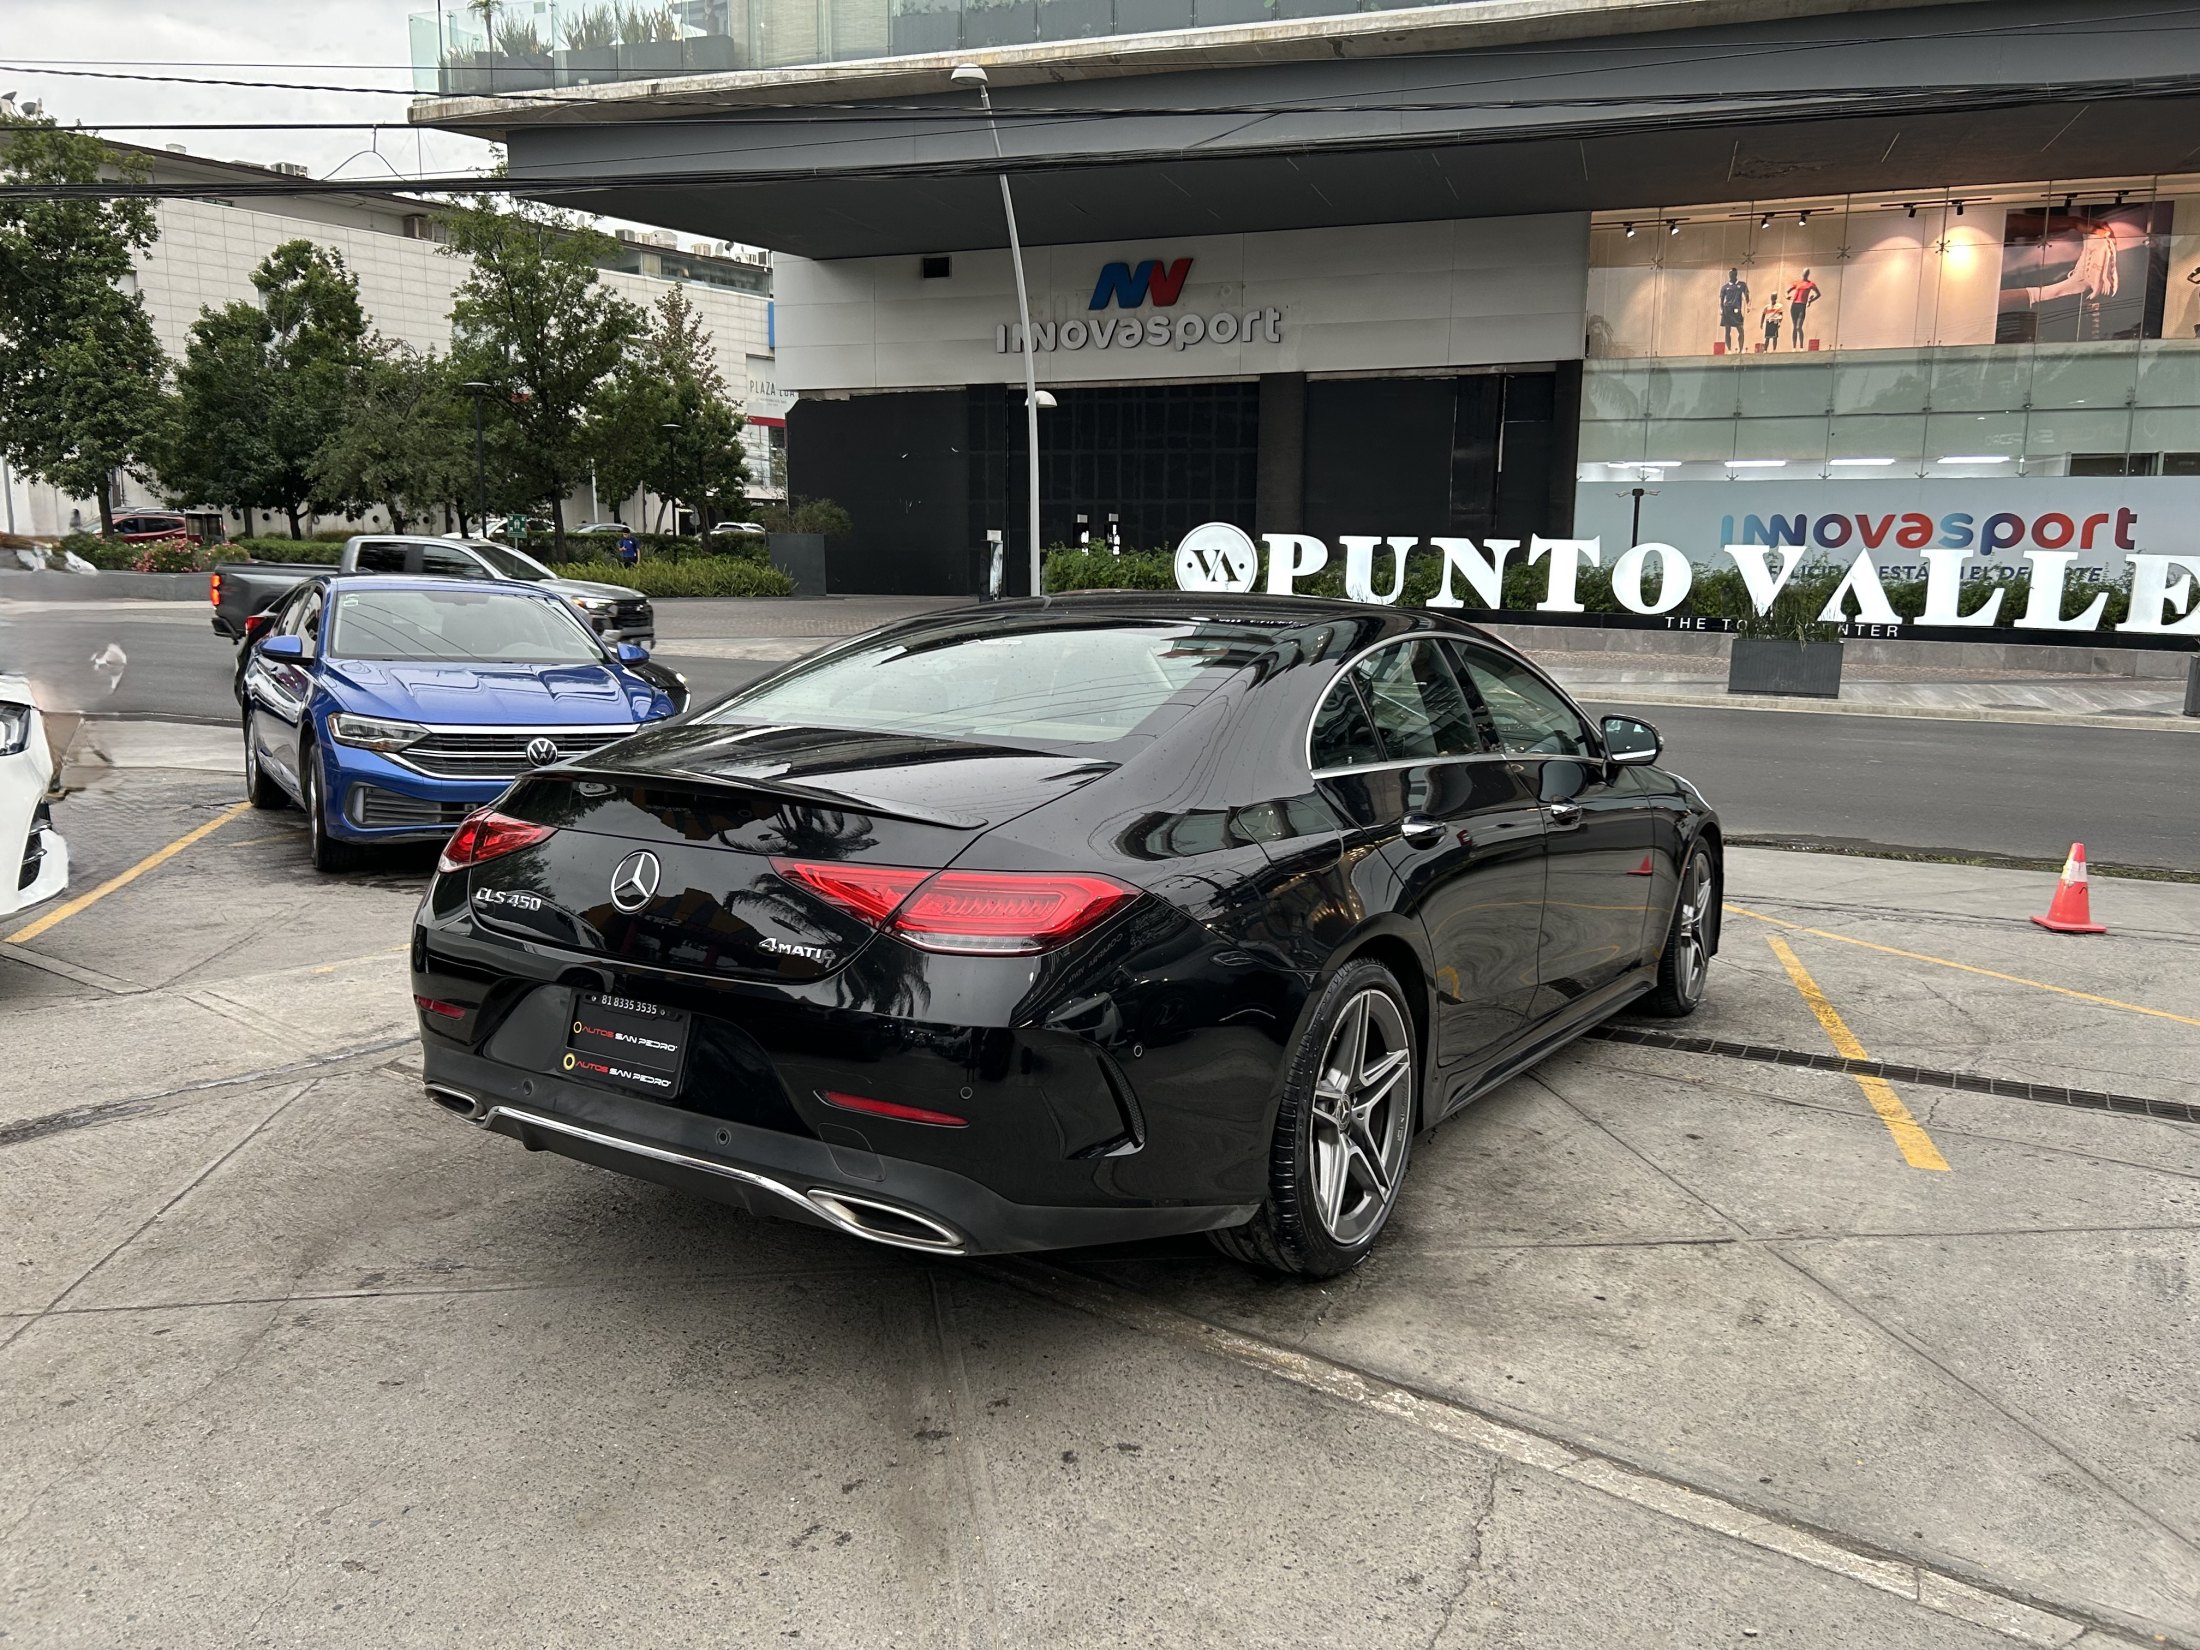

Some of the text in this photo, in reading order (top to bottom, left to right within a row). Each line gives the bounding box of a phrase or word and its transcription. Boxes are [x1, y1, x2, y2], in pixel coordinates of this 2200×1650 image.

[749, 379, 776, 395] PLAZA
[1261, 532, 2200, 635] PUNTO VALLE
[1665, 616, 1707, 630] THE
[475, 886, 542, 911] CLS 450
[601, 994, 658, 1015] 81 8335 3535
[582, 1025, 676, 1051] AUTOS SAN PEDRO
[575, 1060, 671, 1087] AUTOS SAN PEDRO
